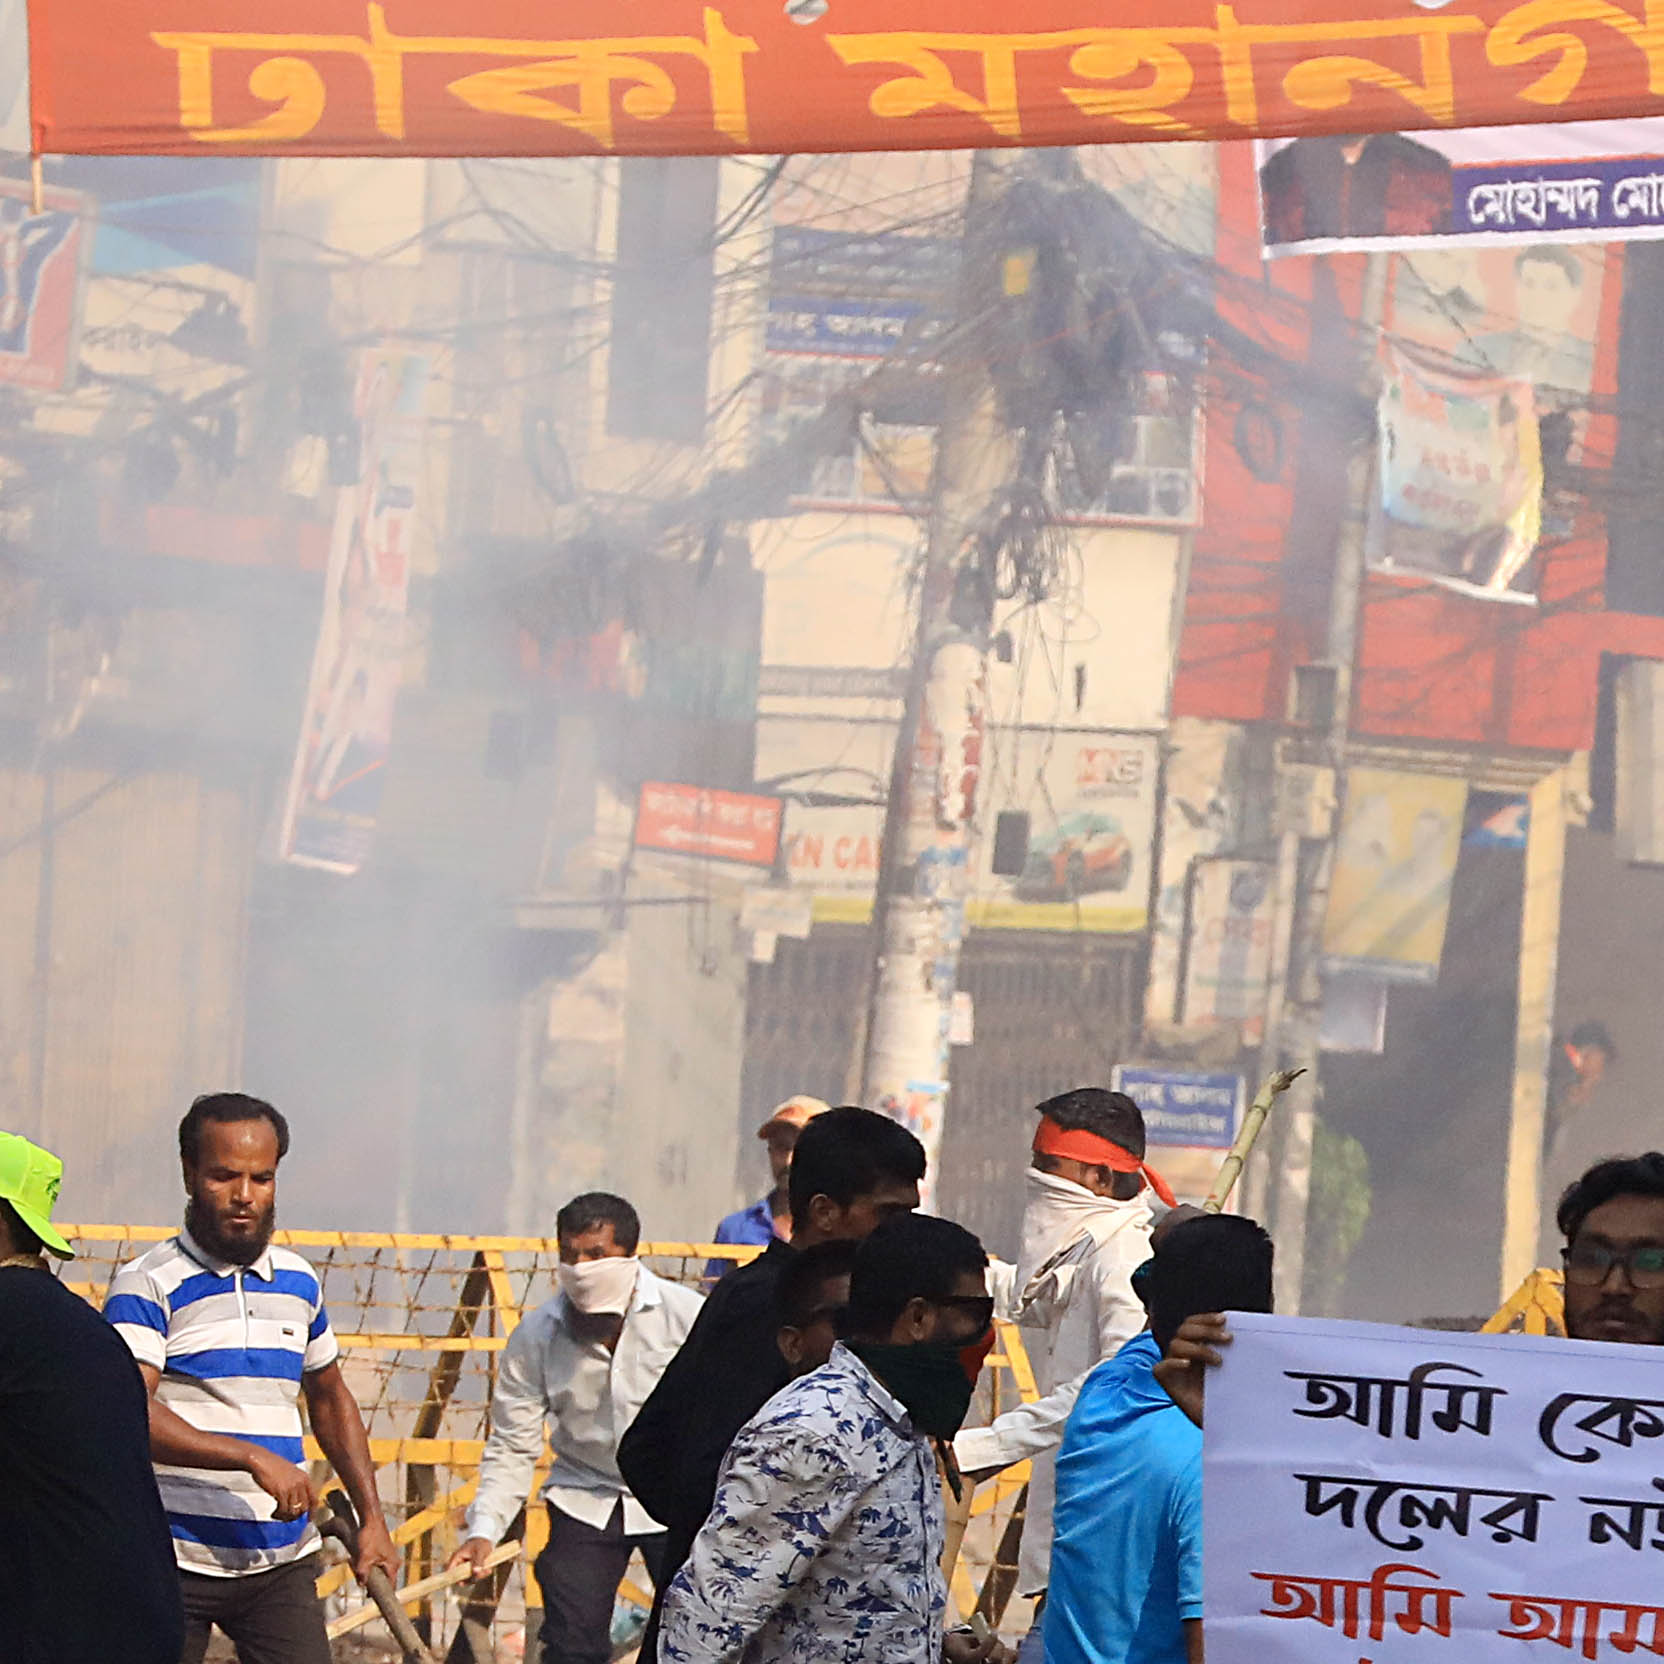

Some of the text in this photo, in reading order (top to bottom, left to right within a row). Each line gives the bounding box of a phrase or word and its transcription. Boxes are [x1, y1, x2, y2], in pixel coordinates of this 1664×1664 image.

[150, 2, 759, 149] ঢাকা
[1284, 1362, 1508, 1440] আমি
[1293, 1473, 1554, 1552] দলের
[1251, 1563, 1464, 1641] আমি
